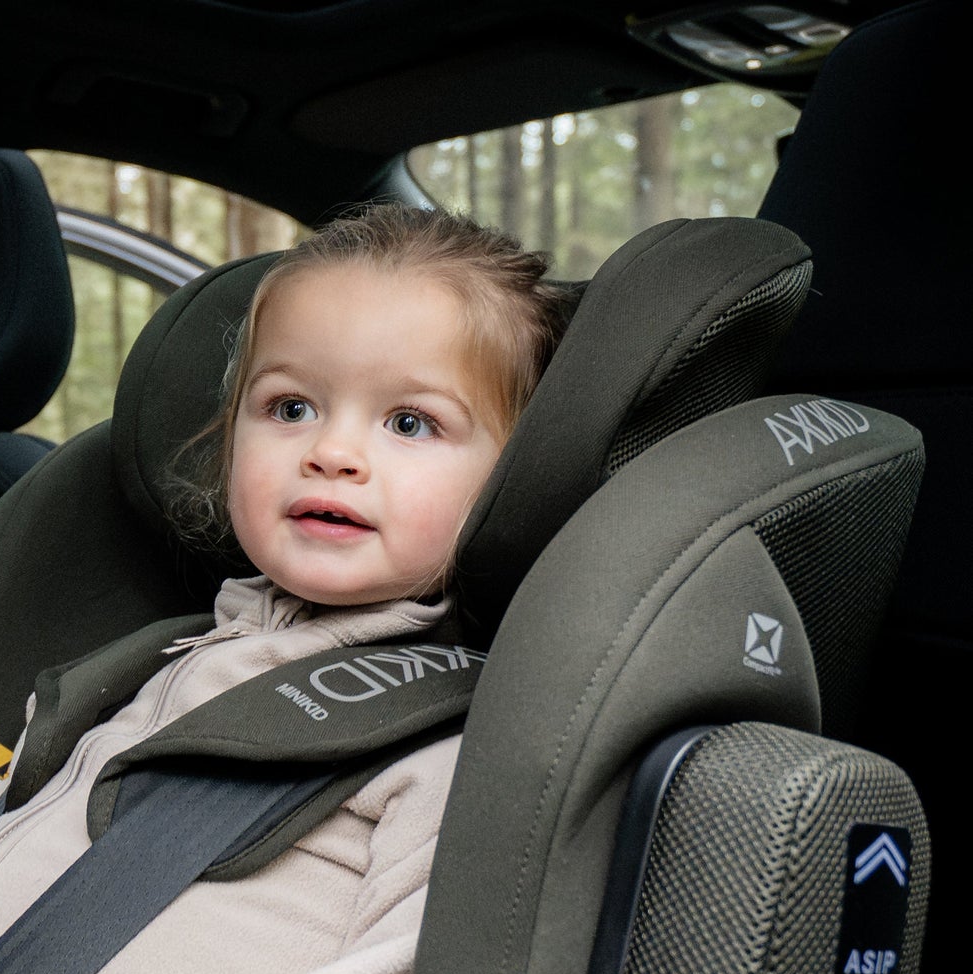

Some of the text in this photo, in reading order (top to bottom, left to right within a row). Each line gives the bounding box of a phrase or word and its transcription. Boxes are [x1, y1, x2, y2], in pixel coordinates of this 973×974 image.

[764, 399, 870, 466] AXKID
[275, 683, 329, 721] MINIKID
[309, 645, 488, 702] XKID
